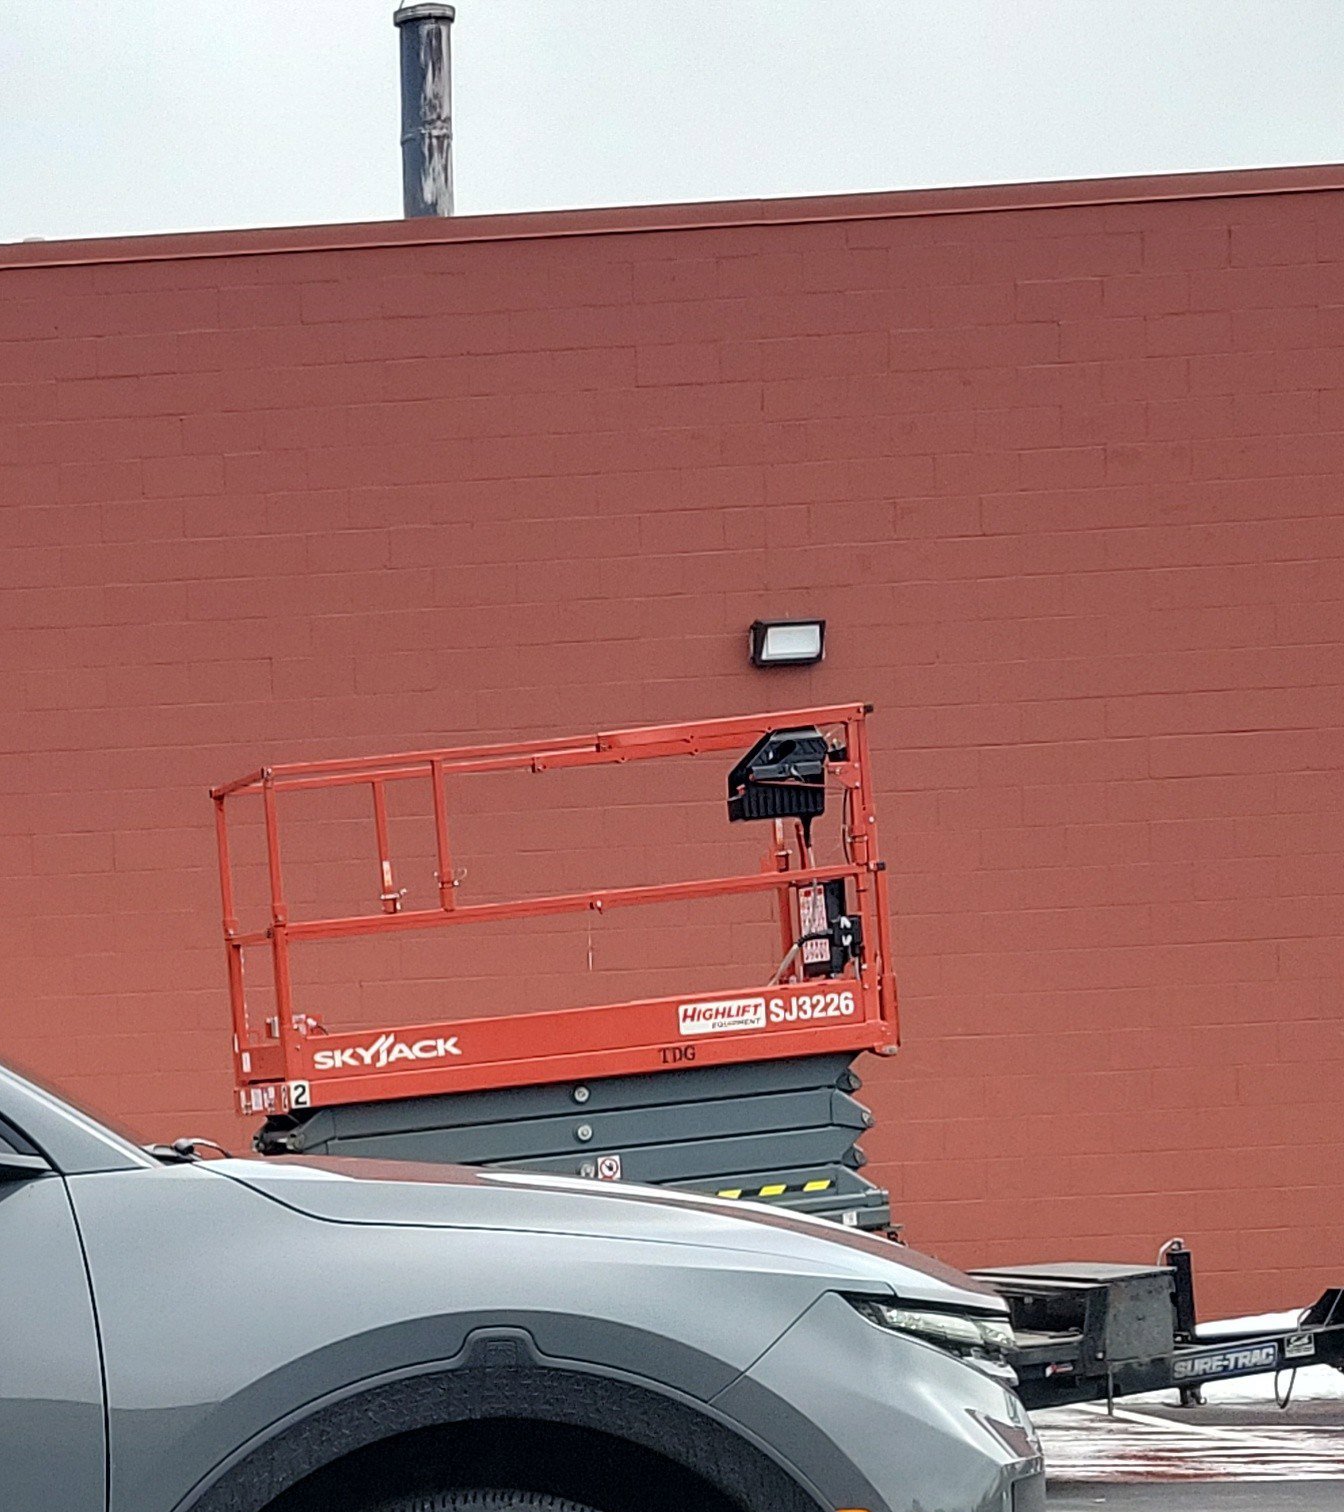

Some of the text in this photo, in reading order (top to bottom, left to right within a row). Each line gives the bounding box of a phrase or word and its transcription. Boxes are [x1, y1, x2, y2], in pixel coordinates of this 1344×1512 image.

[681, 1002, 762, 1024] HIGHLIFT
[769, 991, 855, 1023] SJ3226
[313, 1033, 463, 1070] SKYJACK
[660, 1045, 696, 1065] TDG
[293, 1084, 308, 1106] 2
[1173, 1347, 1275, 1379] SURE-TRAC
